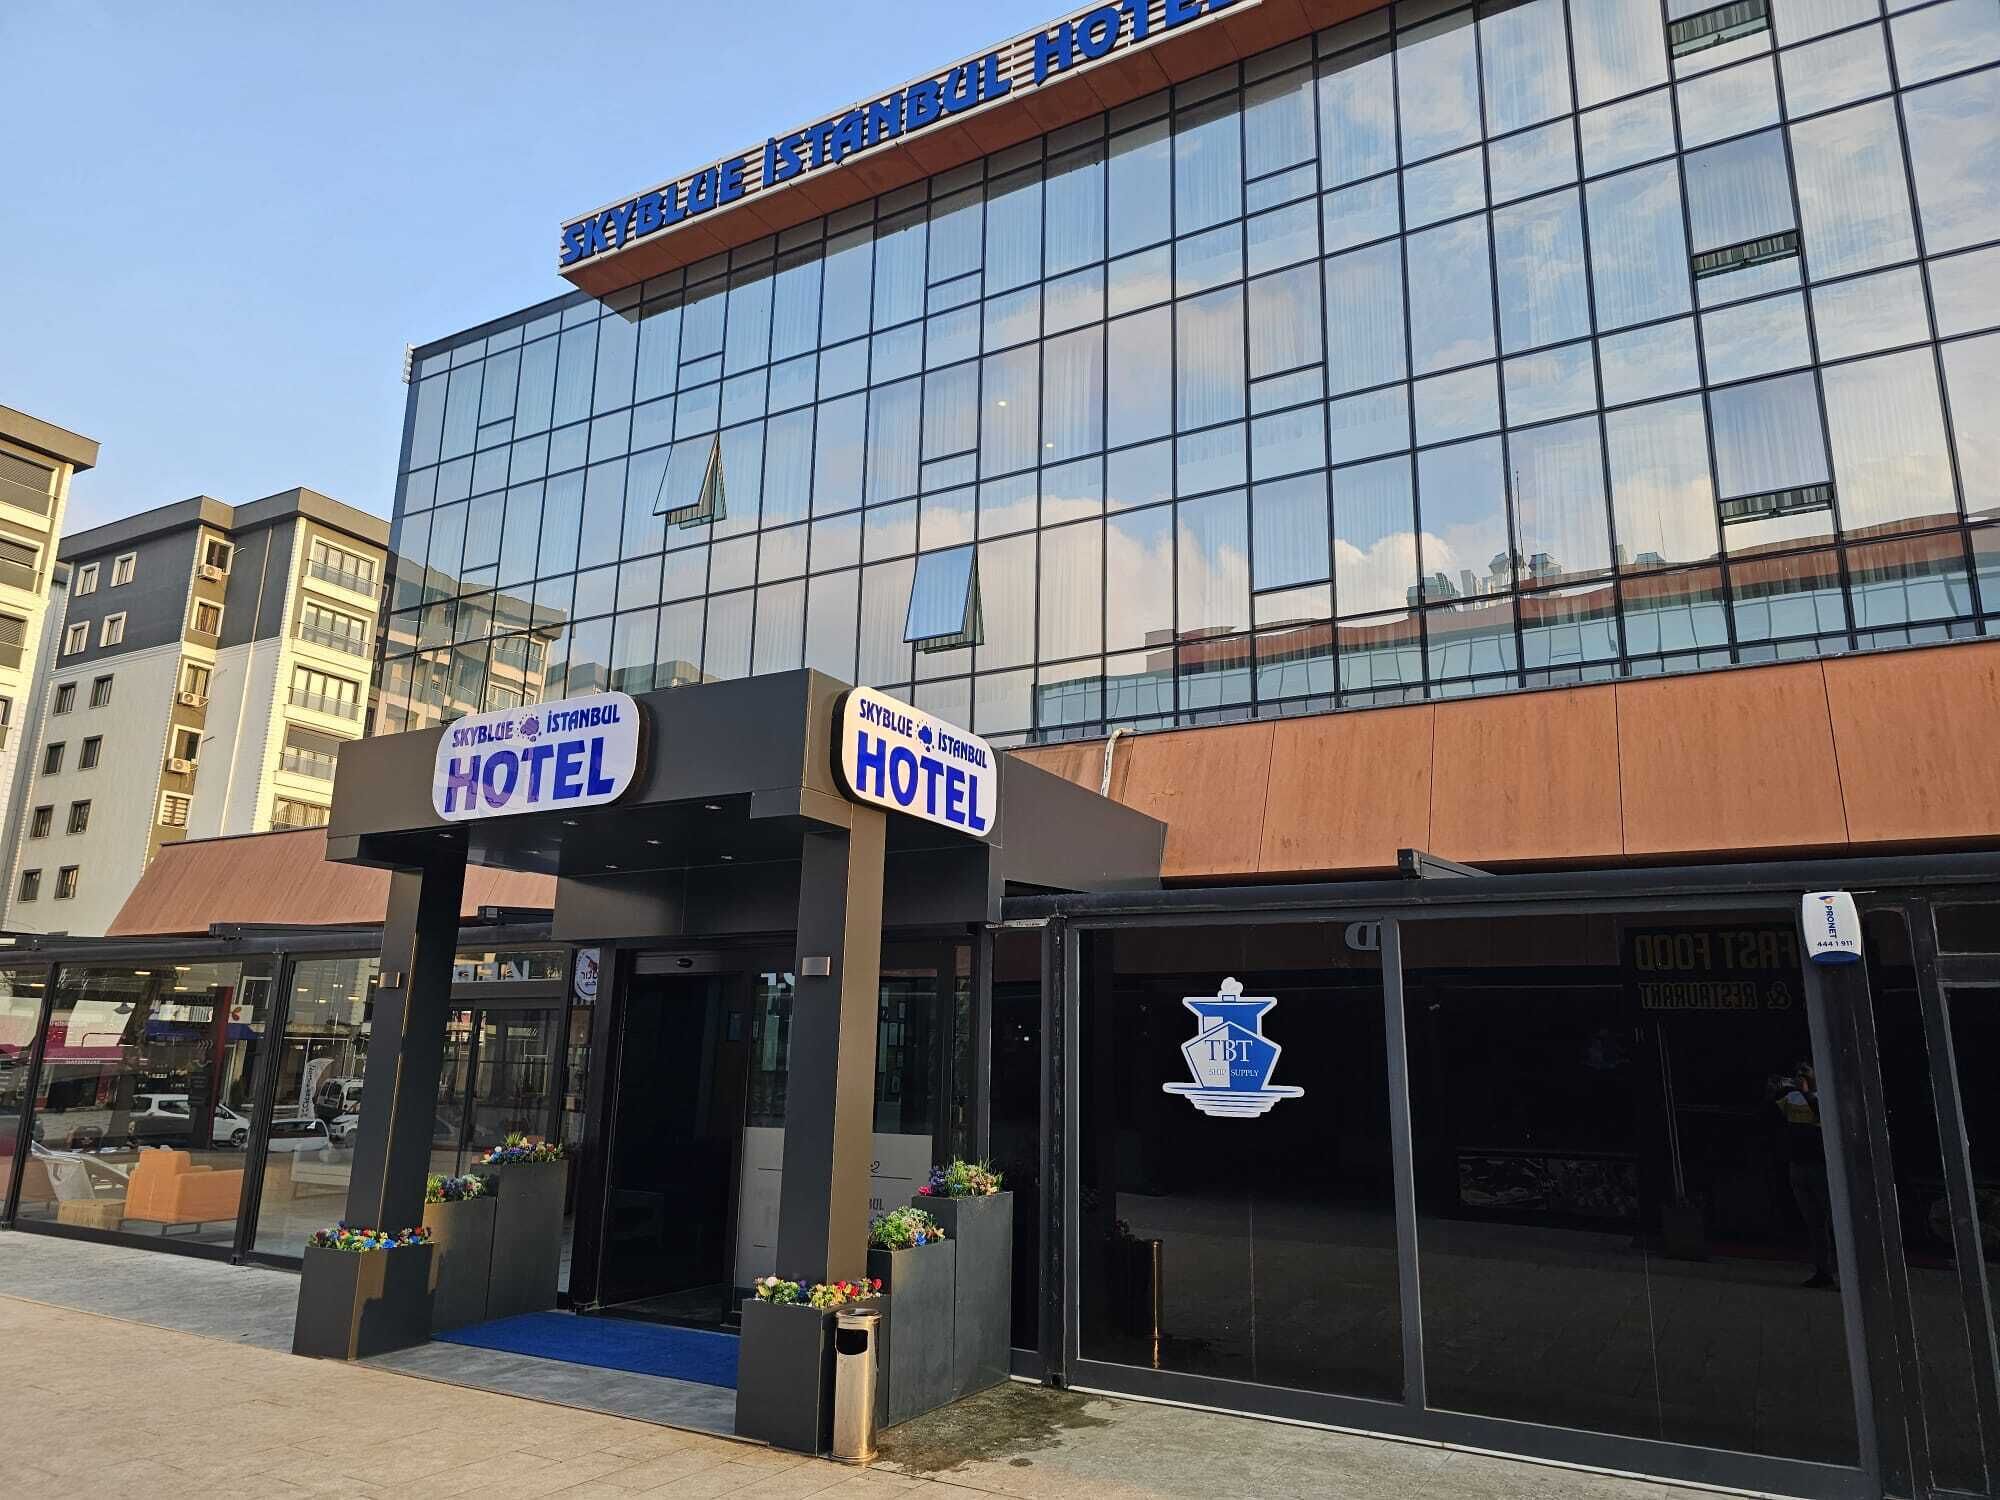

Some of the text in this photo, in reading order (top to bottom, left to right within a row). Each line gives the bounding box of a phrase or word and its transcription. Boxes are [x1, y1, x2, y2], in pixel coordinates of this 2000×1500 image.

[561, 0, 1240, 266] SKYBLUE İSTANBUL HOTE
[452, 703, 621, 748] SKYBLUE İSTANBUL
[860, 698, 988, 769] SKYBLUE İSTANBUL
[444, 736, 616, 813] HOTEL
[856, 730, 986, 832] HOTEL
[1825, 905, 1838, 939] PRONET
[1204, 1039, 1253, 1062] TBT
[1230, 1068, 1260, 1077] SUPPLY
